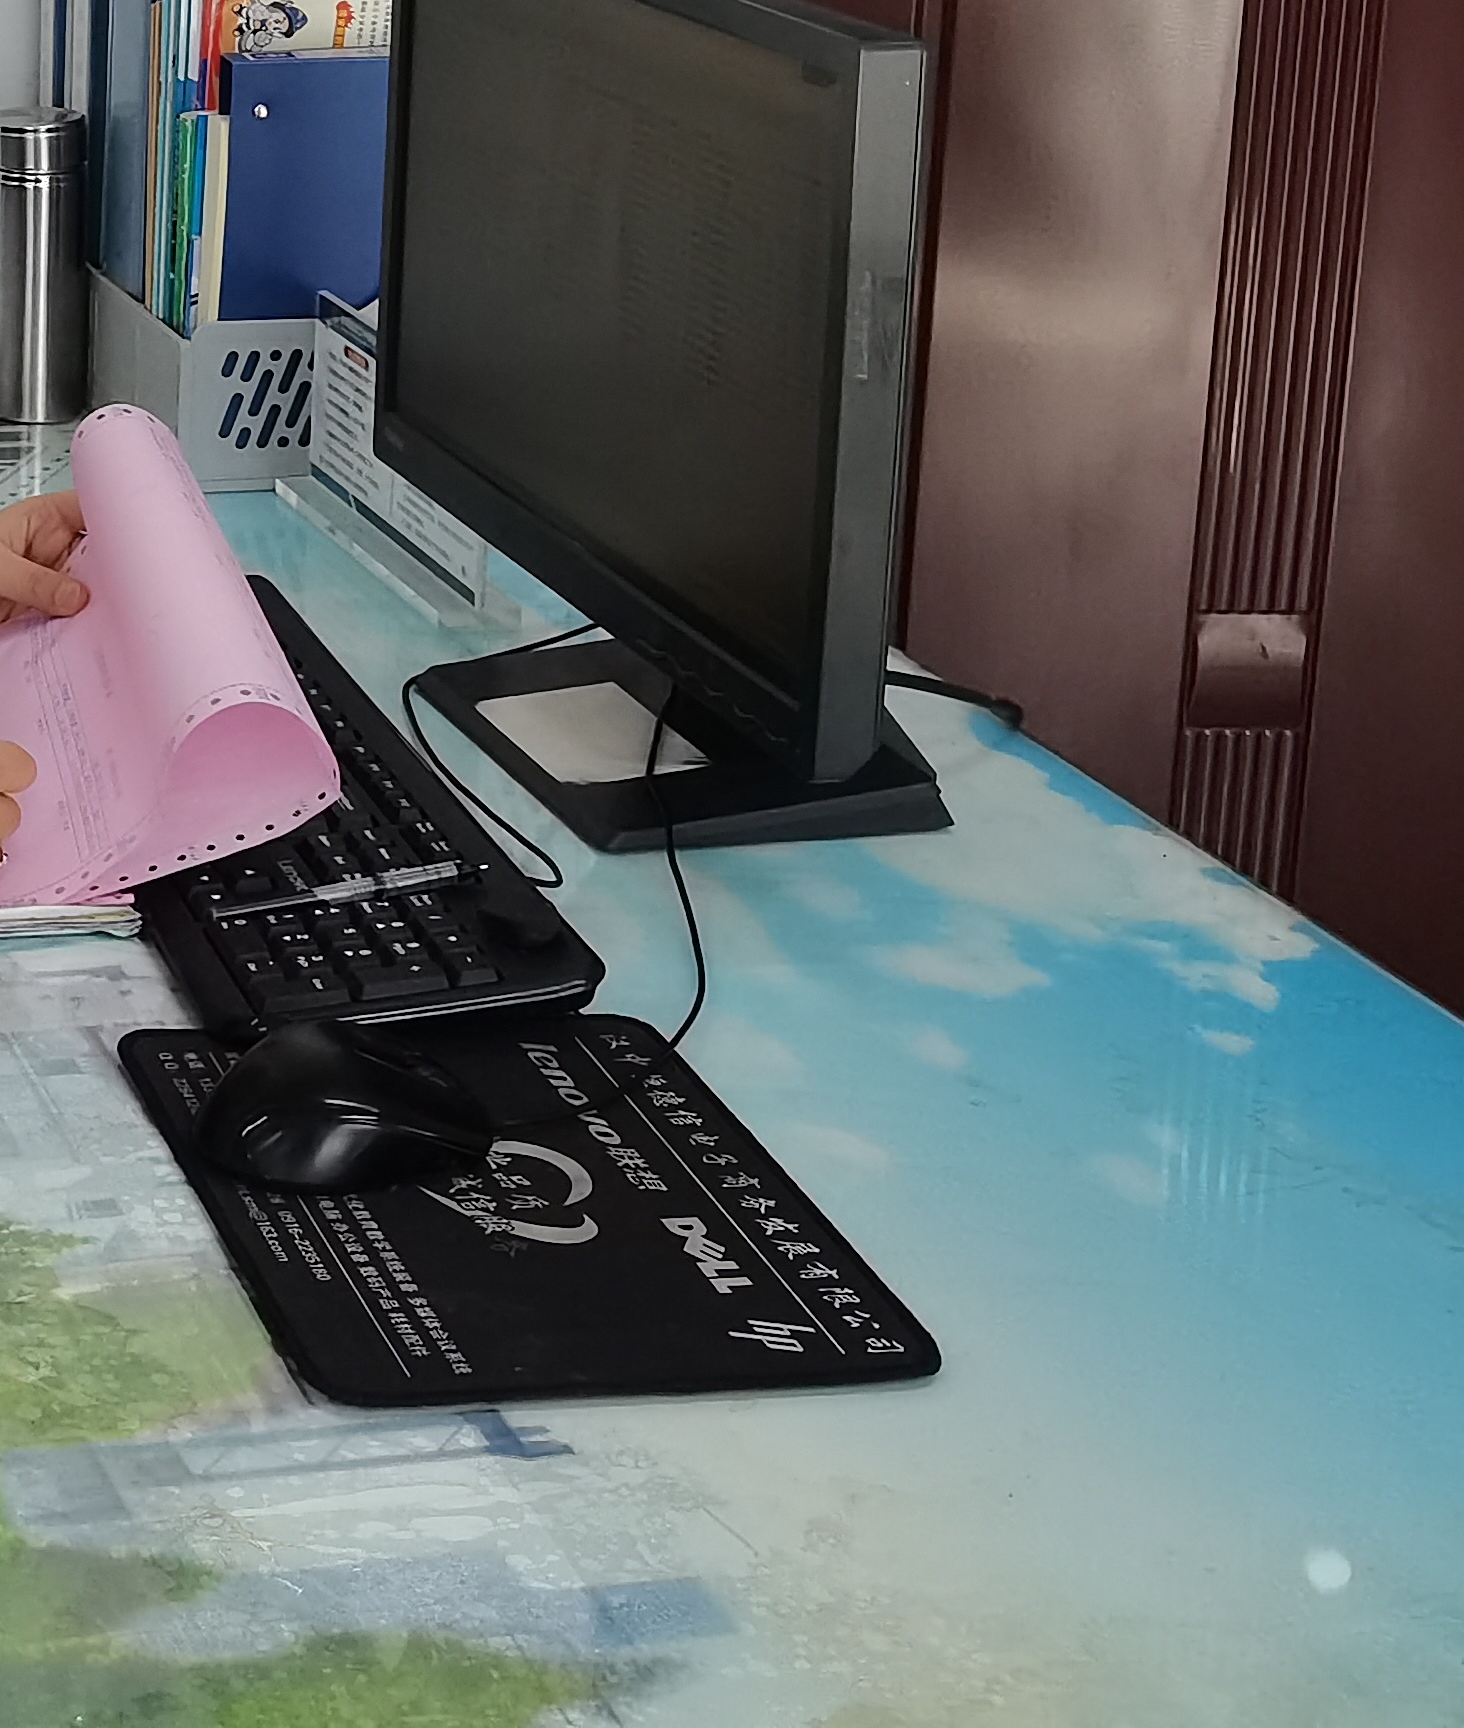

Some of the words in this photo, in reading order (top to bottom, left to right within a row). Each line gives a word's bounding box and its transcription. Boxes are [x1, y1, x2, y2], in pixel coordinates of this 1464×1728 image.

[517, 1041, 622, 1146] lenovo
[606, 1146, 669, 1192] 联想
[659, 1216, 755, 1295] DELL
[727, 1318, 817, 1353] hp
